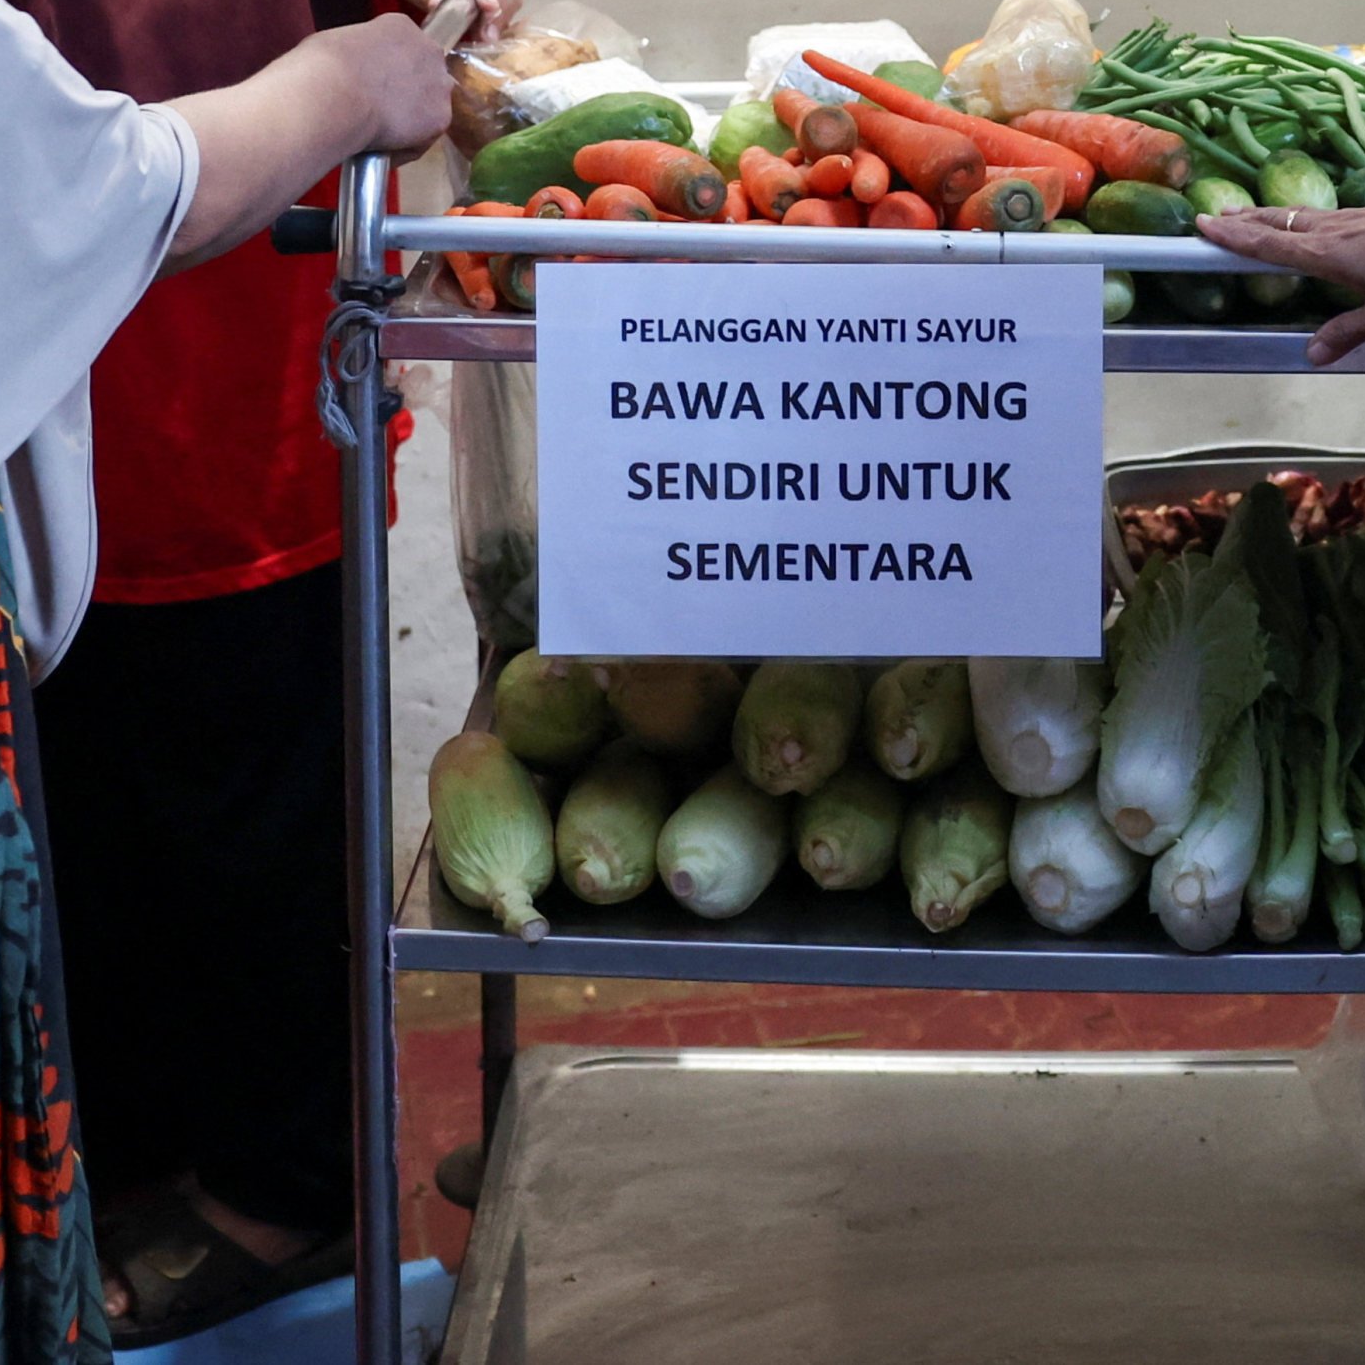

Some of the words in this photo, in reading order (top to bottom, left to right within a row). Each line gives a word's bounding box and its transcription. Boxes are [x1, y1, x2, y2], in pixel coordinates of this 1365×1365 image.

[620, 318, 807, 344] PELANGGAN
[816, 318, 907, 343] YANTI
[916, 318, 1017, 343] SAYUR
[611, 381, 765, 420] BAWA
[781, 380, 1028, 421] KANTONG
[627, 462, 819, 502] SENDIRI
[838, 462, 1012, 502] UNTUK
[666, 542, 973, 582] SEMENTARA
